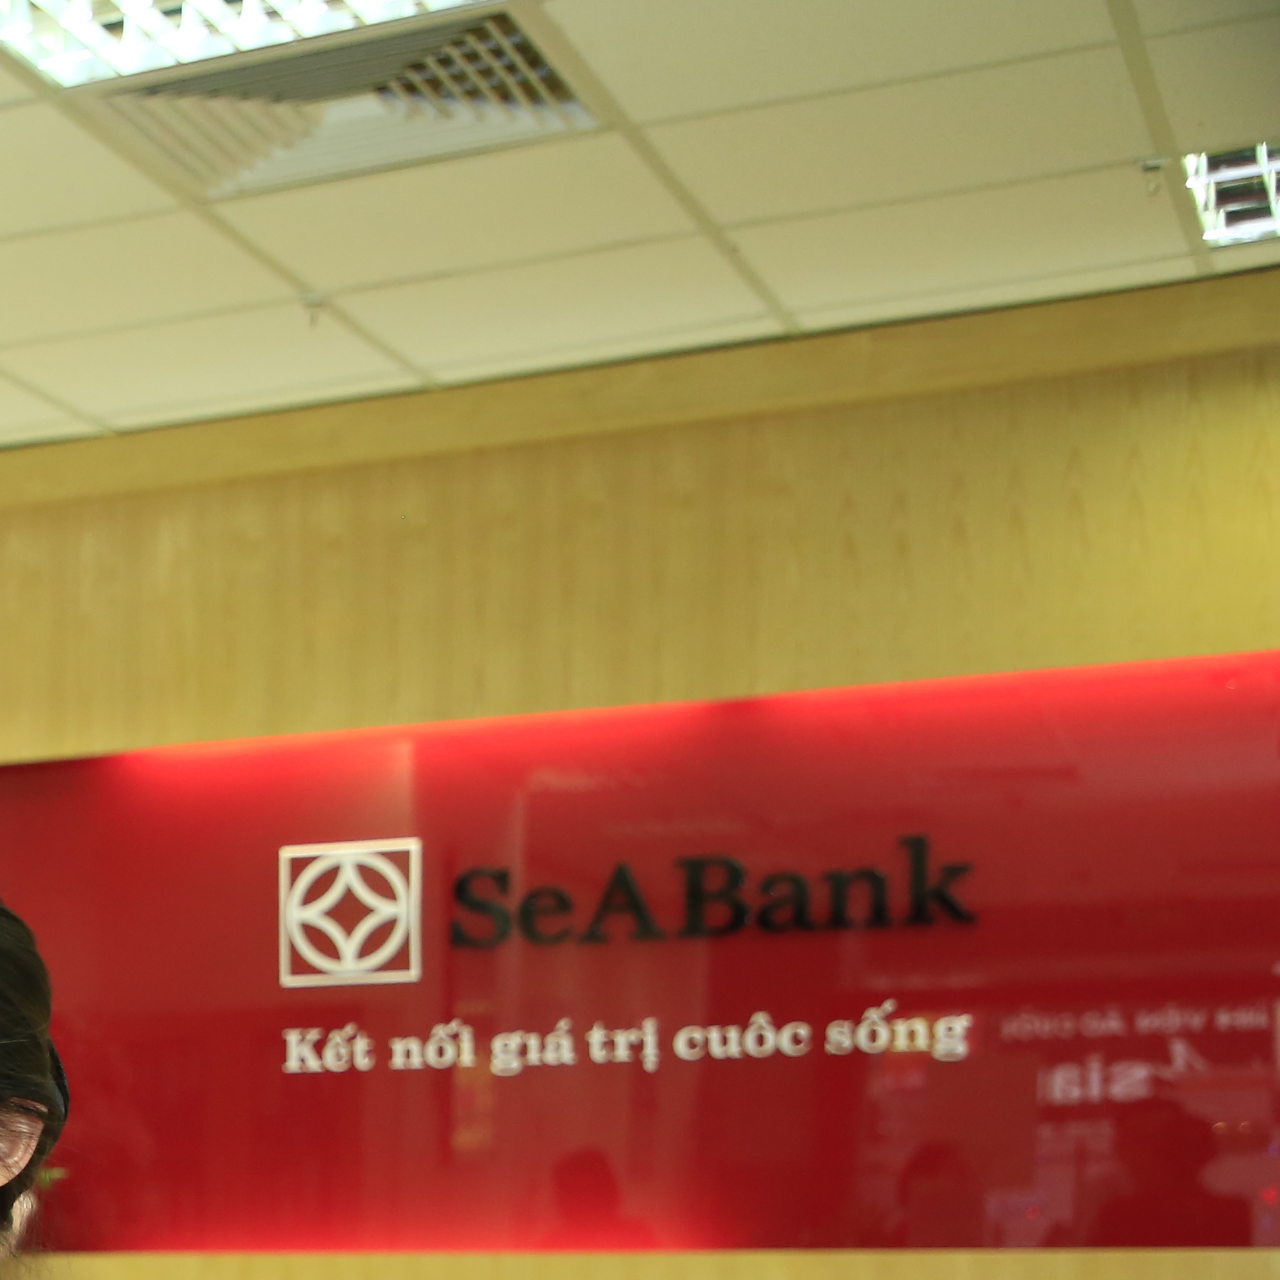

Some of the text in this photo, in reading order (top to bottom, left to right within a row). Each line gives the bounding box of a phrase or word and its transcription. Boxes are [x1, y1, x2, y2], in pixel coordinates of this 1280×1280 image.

[450, 834, 976, 948] SeABank
[282, 1021, 375, 1074] Kết
[389, 1018, 477, 1071] nối
[489, 1018, 577, 1077] giá
[585, 1017, 658, 1074] trị
[824, 998, 973, 1062] sống
